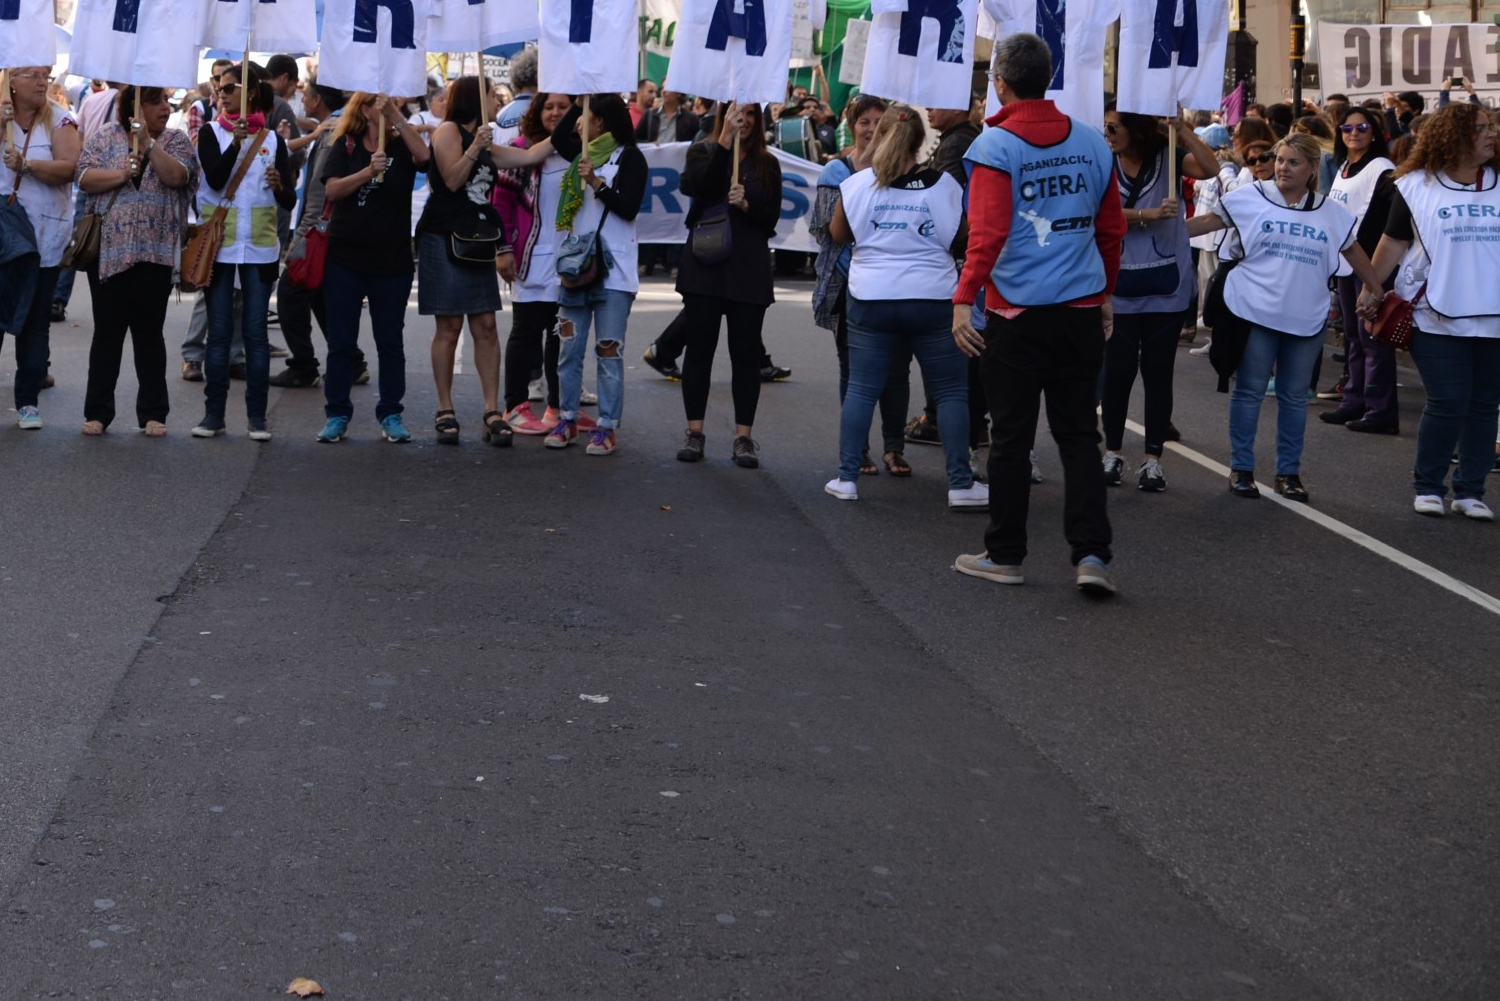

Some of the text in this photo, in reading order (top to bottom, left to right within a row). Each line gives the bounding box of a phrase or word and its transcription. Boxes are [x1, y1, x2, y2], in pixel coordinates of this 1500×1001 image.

[1020, 172, 1089, 202] CTERA
[1437, 204, 1500, 219] CTER
[1261, 220, 1328, 244] CTERA
